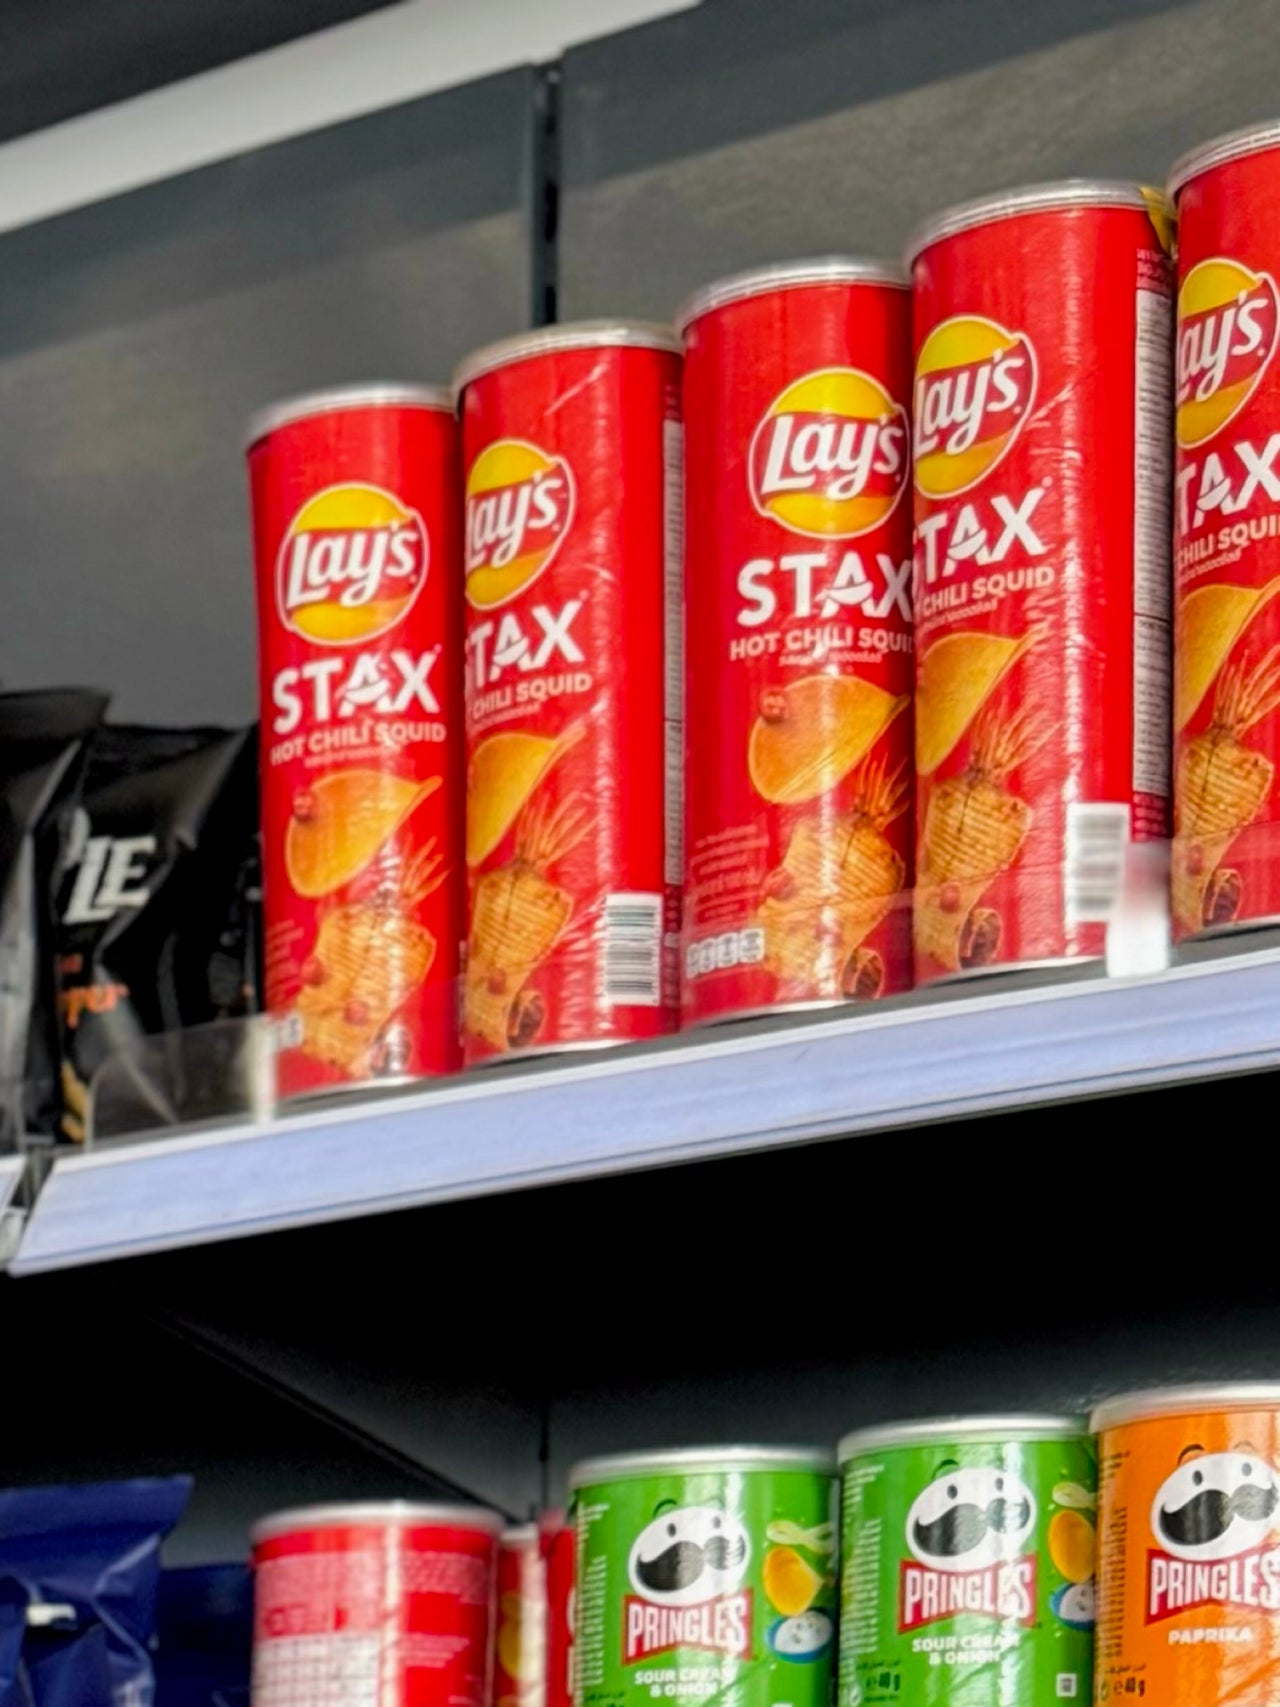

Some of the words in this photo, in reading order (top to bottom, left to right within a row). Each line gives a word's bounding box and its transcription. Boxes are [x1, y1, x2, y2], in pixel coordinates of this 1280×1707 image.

[761, 412, 905, 500] Lay's
[1177, 432, 1280, 534] TAX
[287, 521, 419, 608] Lay's
[914, 487, 1047, 598] TAX
[972, 565, 1055, 600] SQUID
[730, 632, 781, 662] HOT
[272, 648, 440, 735] STAX
[516, 671, 593, 704] SQUID
[271, 734, 305, 767] HOT
[627, 1590, 749, 1658] PRINGLES
[903, 1560, 1032, 1624] PRINGLES
